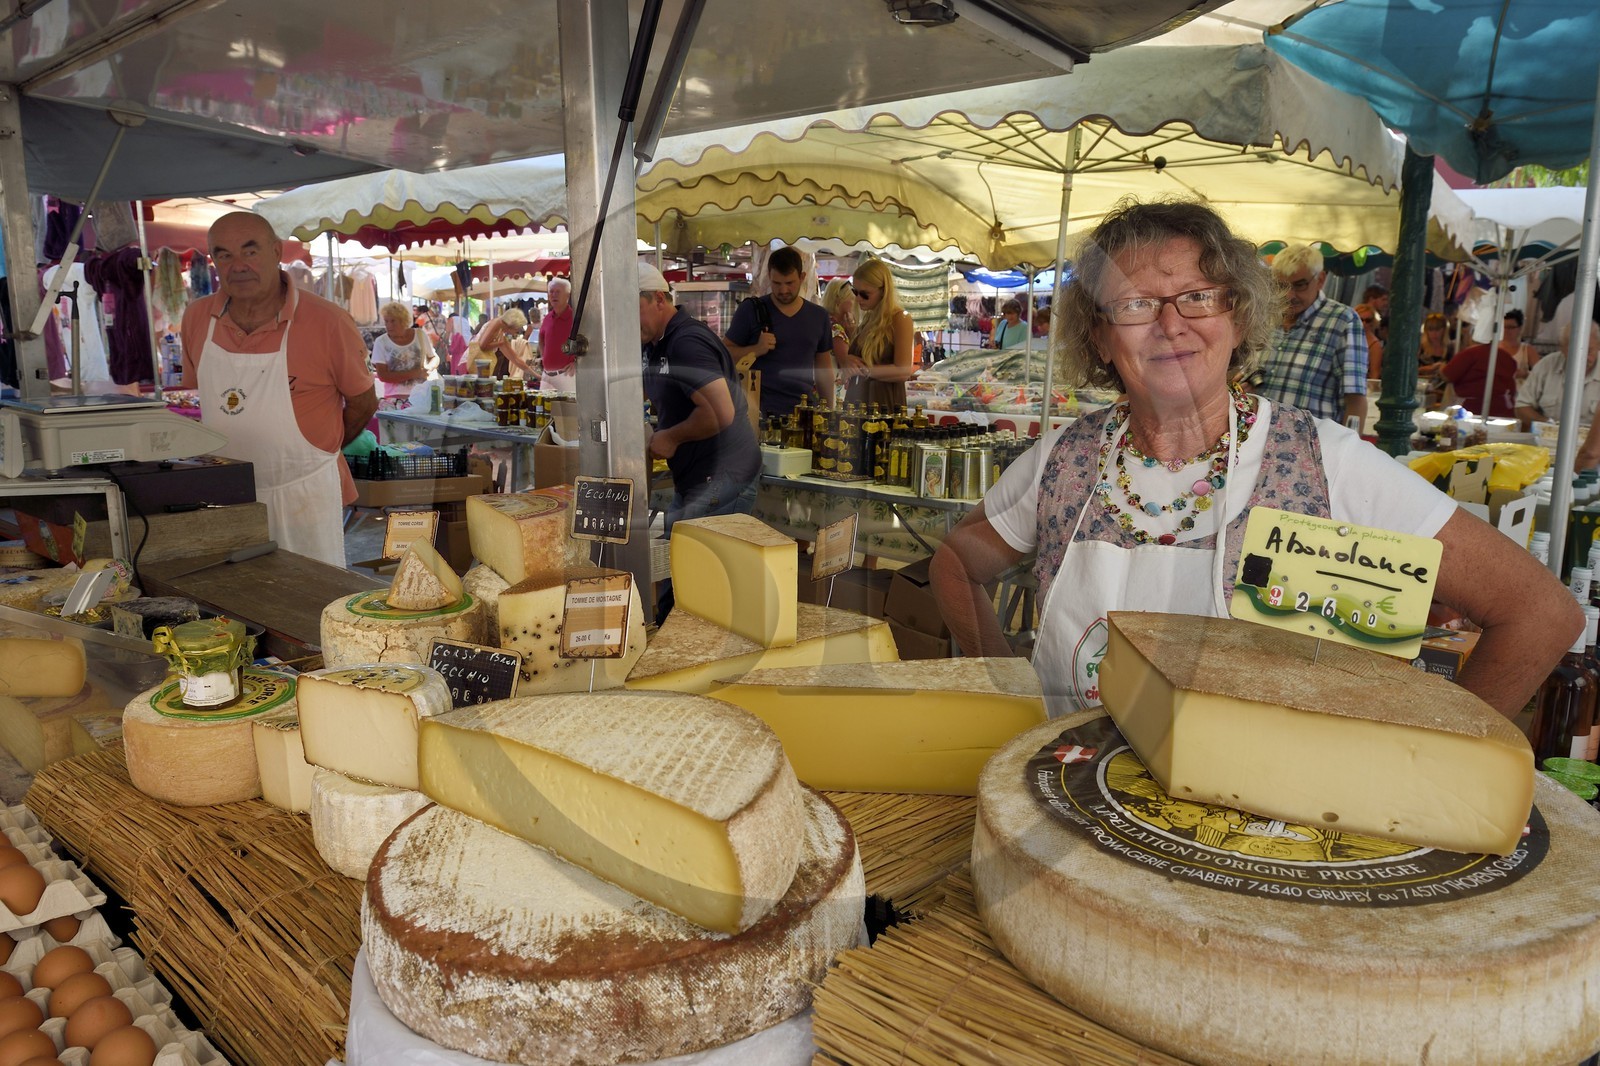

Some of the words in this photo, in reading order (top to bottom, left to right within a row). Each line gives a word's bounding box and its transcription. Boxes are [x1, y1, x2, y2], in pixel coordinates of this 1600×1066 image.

[1361, 531, 1402, 545] planète
[1265, 526, 1428, 583] Abondance
[596, 594, 622, 603] MONTAGNE
[1268, 597, 1279, 607] kg
[1376, 595, 1398, 616] €
[432, 659, 490, 684] VECCHIO
[246, 682, 277, 706] CORSE
[1089, 803, 1194, 857] APPELLATION
[1194, 851, 1310, 879] D'ORIGINE
[1085, 824, 1171, 870] FROMAGERIE
[1170, 864, 1244, 888] CHABERT
[1247, 880, 1303, 897] 74540
[1306, 887, 1371, 902] GRUFFY
[1377, 892, 1399, 901] ou
[1395, 884, 1450, 900] 74570
